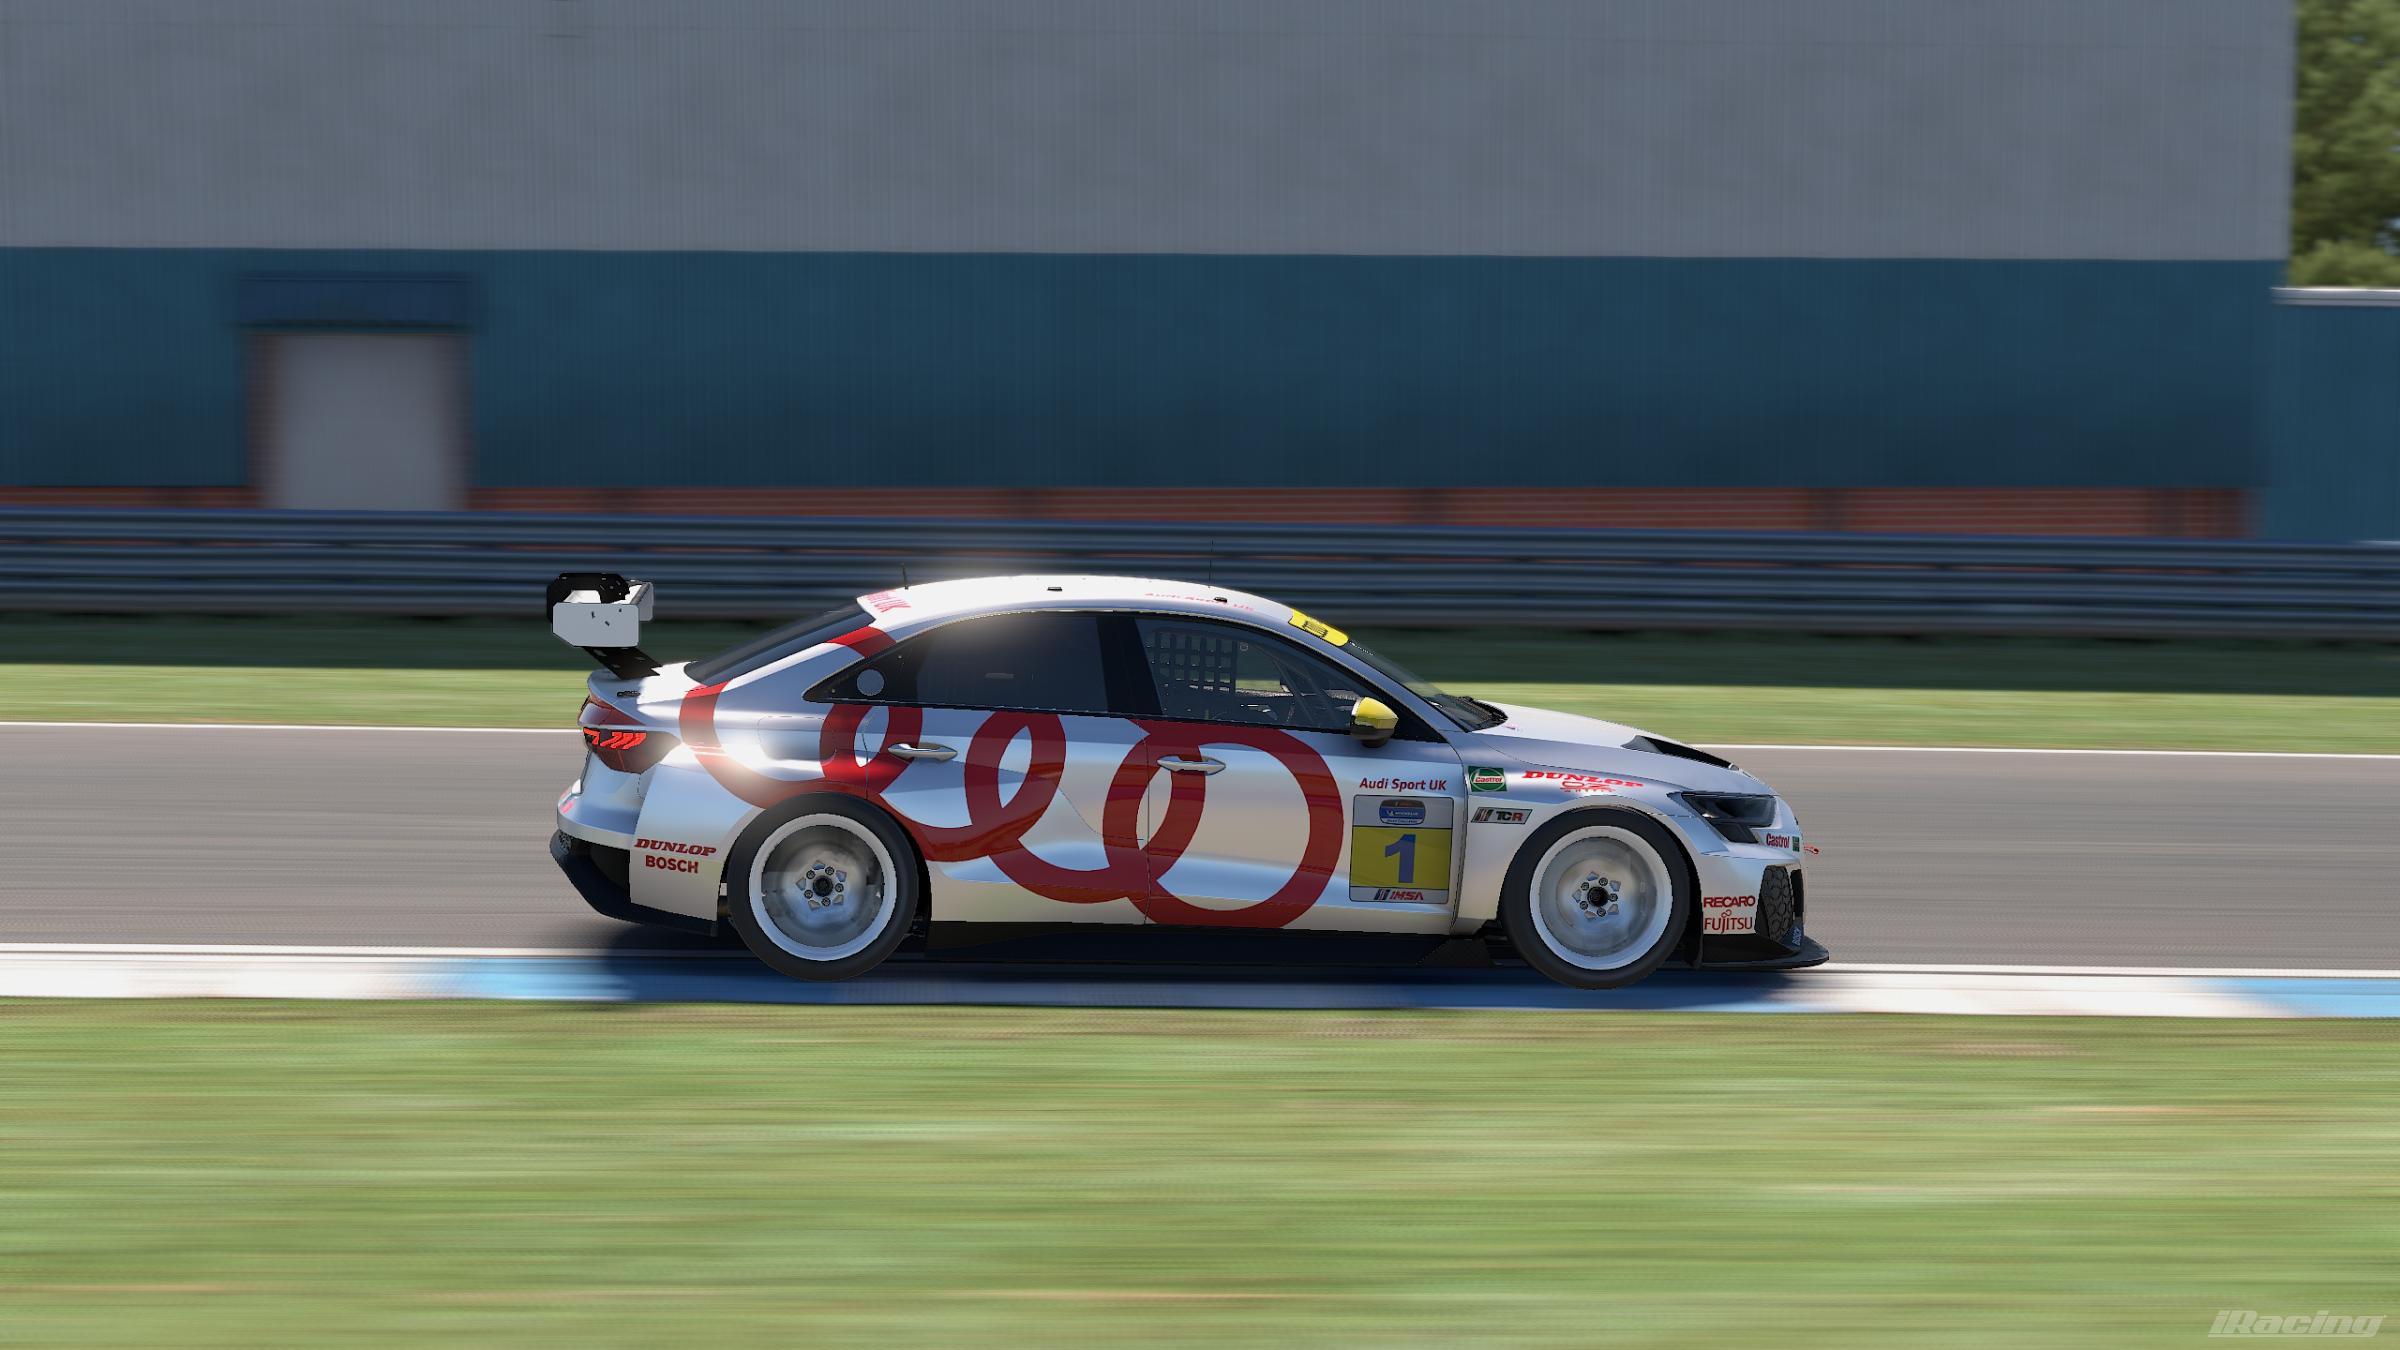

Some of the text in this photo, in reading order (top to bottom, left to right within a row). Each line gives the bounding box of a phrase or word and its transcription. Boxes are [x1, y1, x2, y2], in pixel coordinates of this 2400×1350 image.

[1359, 777, 1448, 793] Audi Sport UK
[1521, 770, 1645, 787] DUNLOP
[1496, 810, 1523, 821] TCR
[634, 839, 717, 856] DUNLOP
[1766, 833, 1791, 849] Castrol
[645, 855, 699, 873] BOSCH
[1384, 834, 1416, 883] 1
[1389, 890, 1424, 901] IMSA
[1703, 895, 1757, 908] RECARO
[1704, 910, 1753, 934] FUJITSU
